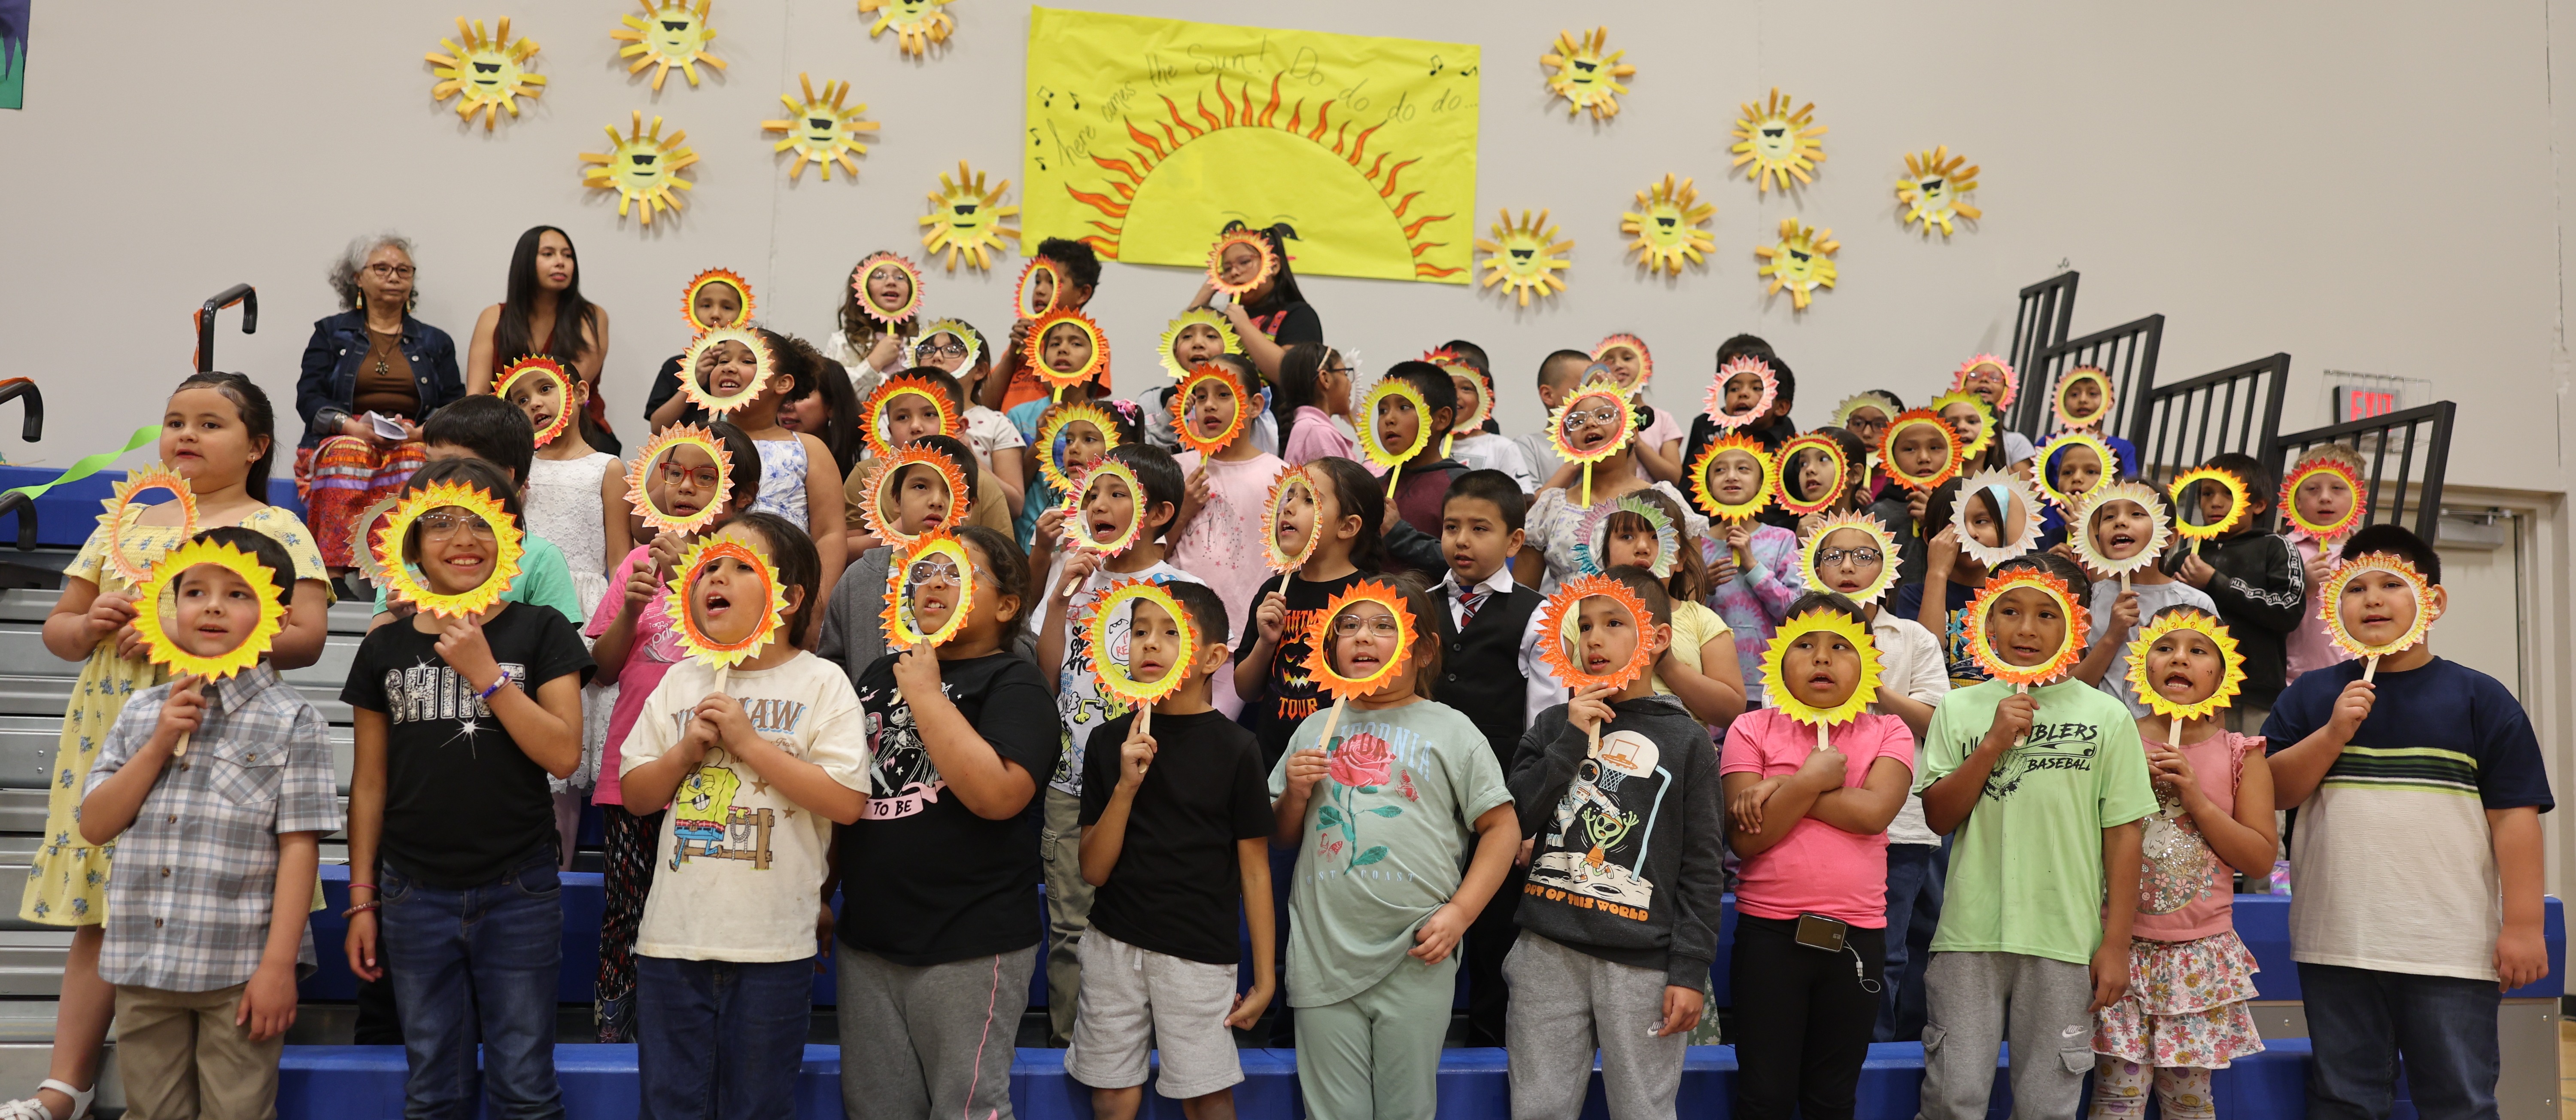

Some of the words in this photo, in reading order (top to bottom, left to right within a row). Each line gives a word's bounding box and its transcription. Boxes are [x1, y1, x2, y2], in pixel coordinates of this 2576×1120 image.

[1046, 118, 1097, 167] here
[1144, 52, 1178, 88] the
[1187, 34, 1267, 75] Sun!
[1290, 46, 1324, 86] Do
[1338, 77, 1370, 112] do
[1387, 90, 1416, 124] do
[1278, 697, 1318, 720] TOUR
[2025, 758, 2091, 773] BASEBALL
[874, 801, 889, 816] TO
[895, 800, 912, 816] BE
[1361, 870, 1415, 883] COAST
[1524, 883, 1544, 897] OUT
[1546, 888, 1566, 901] OF
[1567, 893, 1594, 909] THIS
[1596, 899, 1649, 922] WORLD
